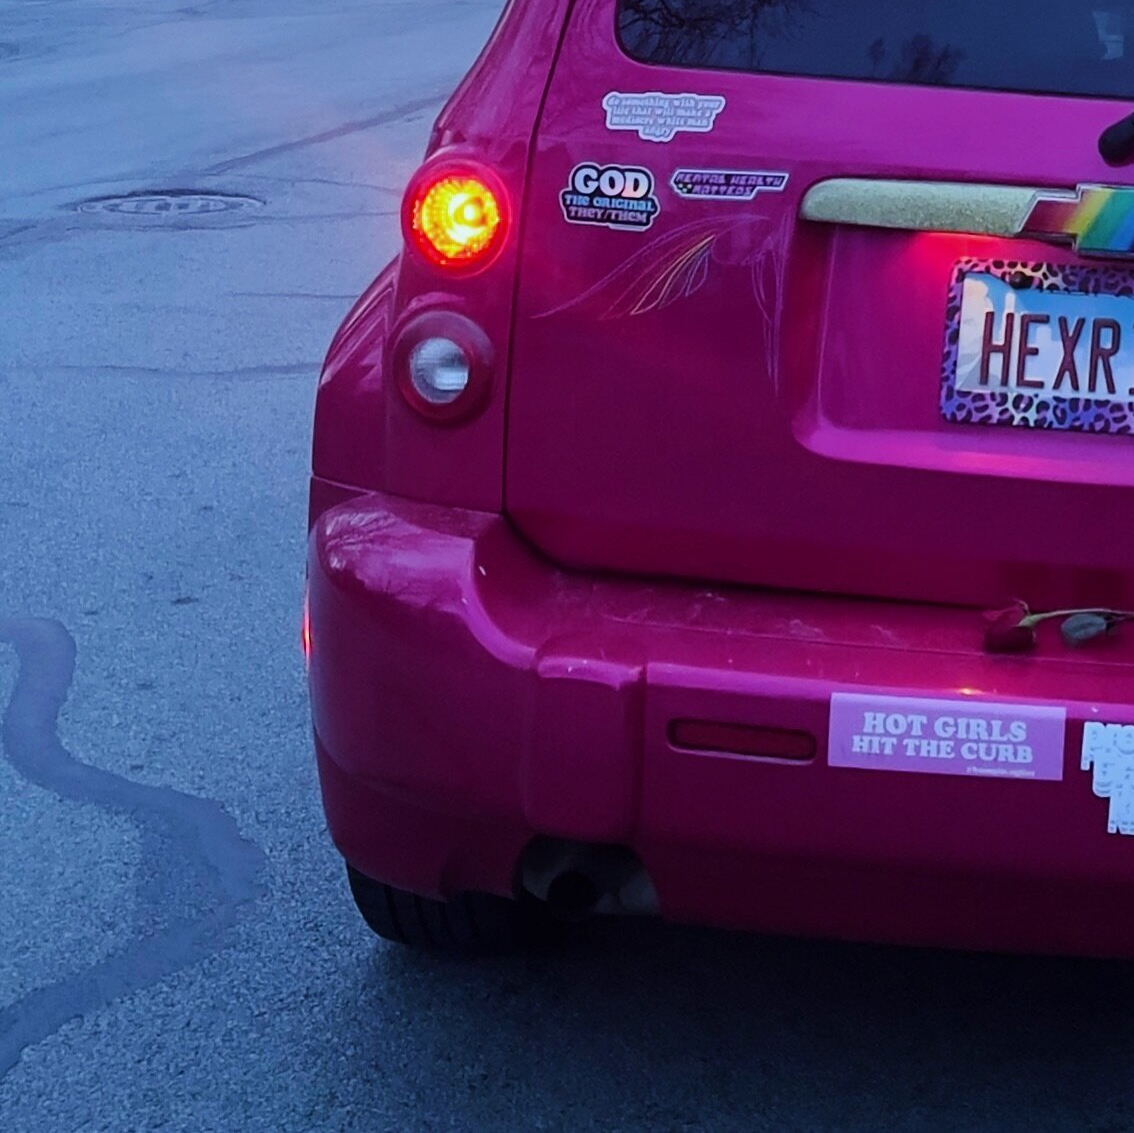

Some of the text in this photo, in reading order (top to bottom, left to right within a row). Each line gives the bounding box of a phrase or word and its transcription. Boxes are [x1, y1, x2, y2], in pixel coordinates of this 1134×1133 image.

[574, 167, 649, 198] GOD
[730, 175, 783, 186] HEALTH
[863, 712, 1027, 742] HOT GIRLS
[852, 735, 1034, 763] HIT THE CURB
